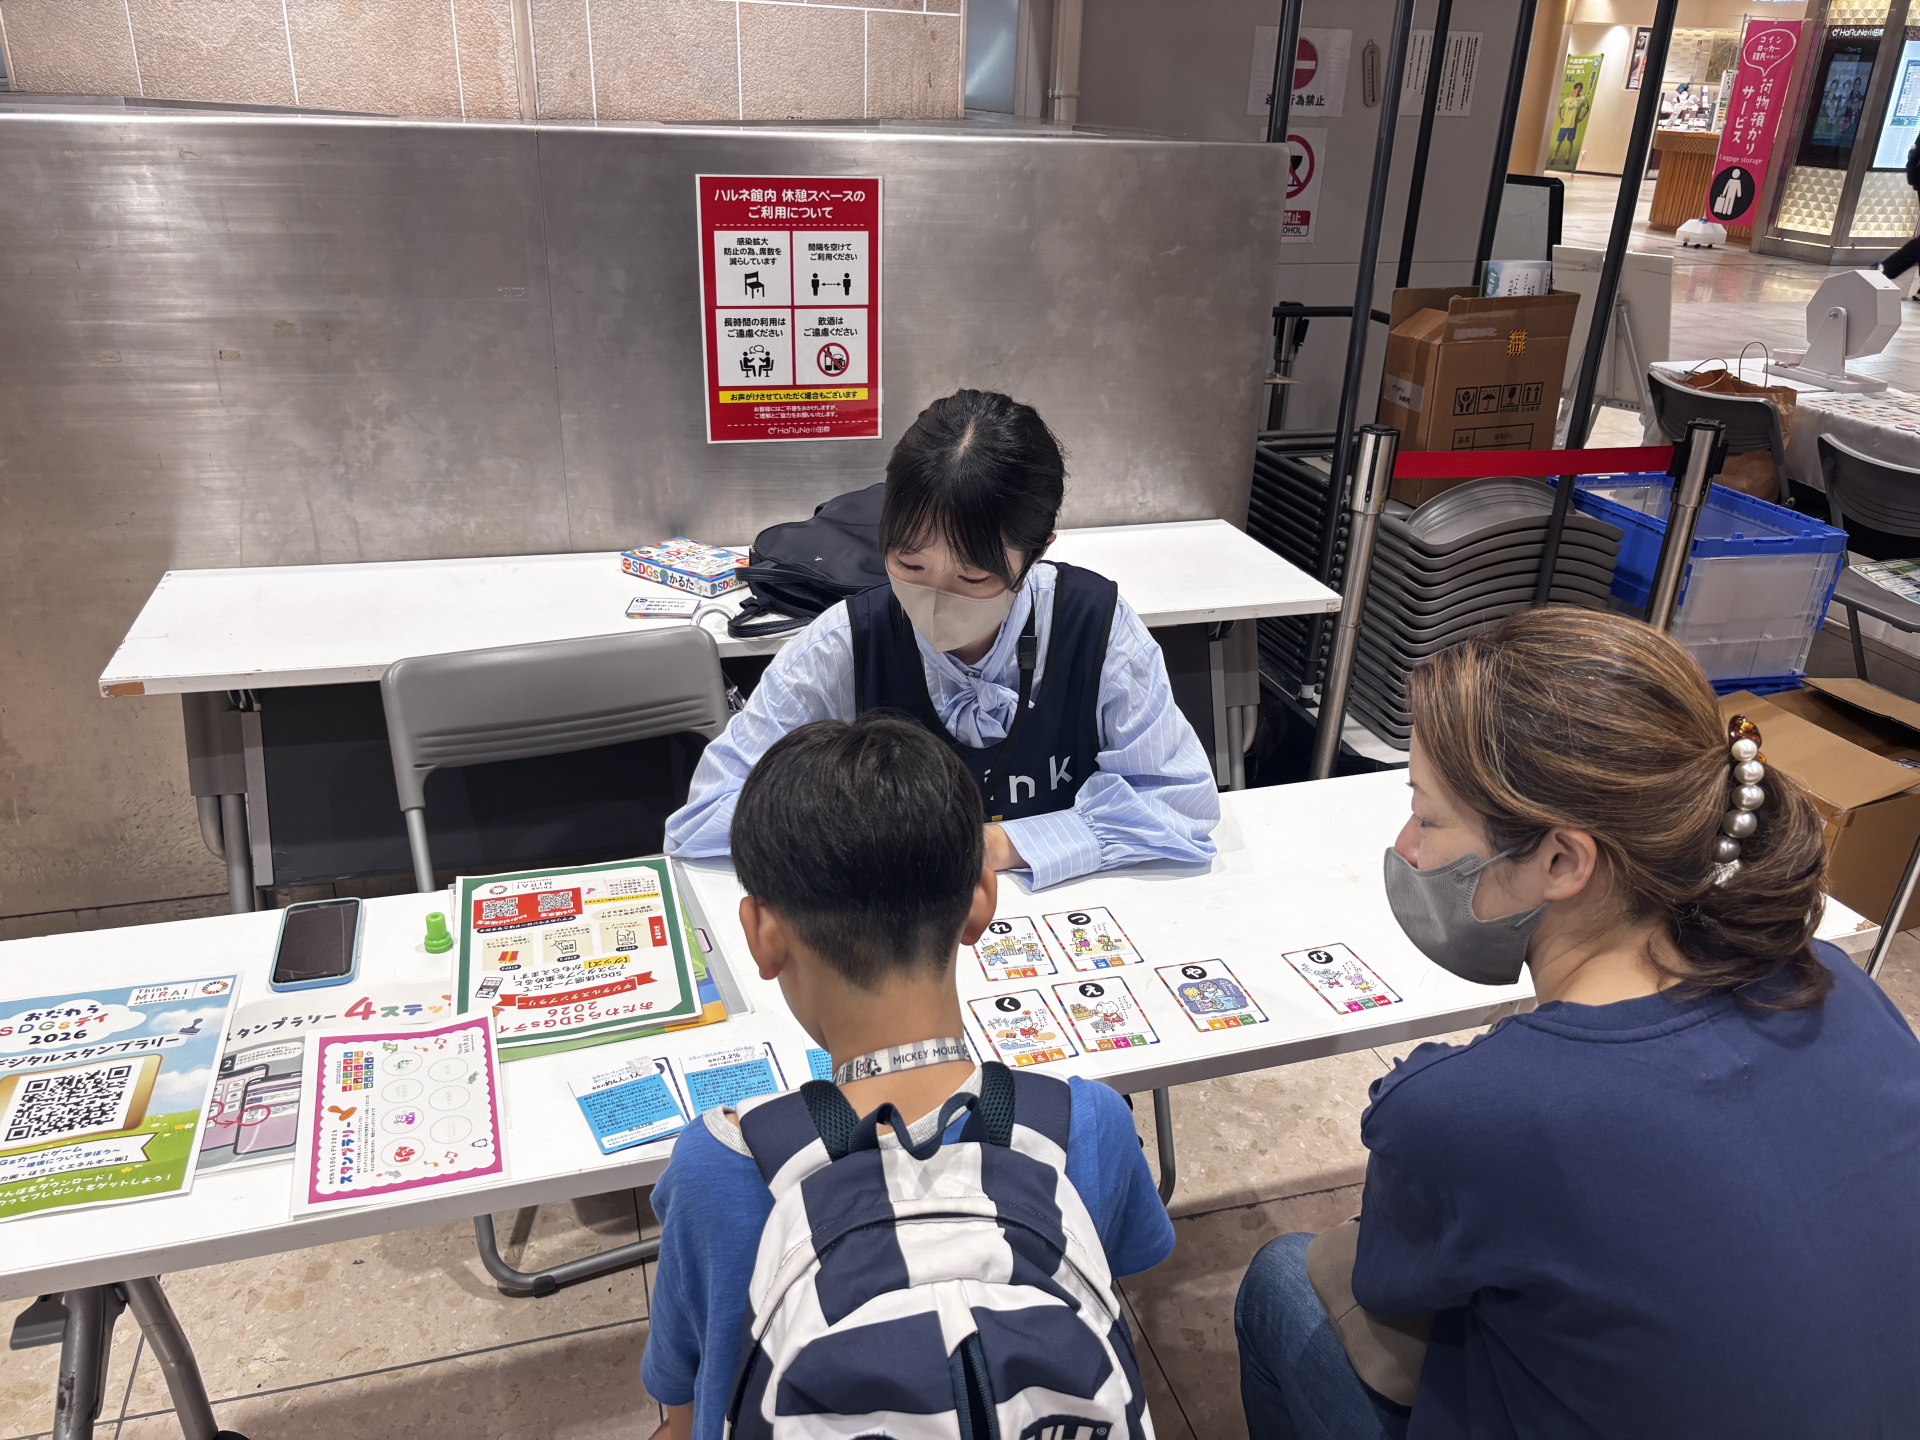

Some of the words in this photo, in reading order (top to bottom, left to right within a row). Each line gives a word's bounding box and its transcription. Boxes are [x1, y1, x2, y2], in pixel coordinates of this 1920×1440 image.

[1760, 36, 1783, 44] コイン
[1757, 45, 1780, 53] ロッカー
[1732, 86, 1755, 144] サービス
[1745, 78, 1774, 156] 荷物預かり
[1719, 153, 1739, 163] Luggage
[1741, 156, 1763, 165] storage
[714, 189, 777, 202] ハルネ館内
[781, 189, 866, 203] 休憩スペースの
[748, 206, 834, 219] ご利用について
[736, 237, 769, 246] 感染拡大
[808, 243, 852, 251] 間隔を空けて
[724, 247, 782, 256] 防止の為、席数を
[810, 253, 858, 261] ご利用ください
[729, 257, 777, 265] 減らしています
[724, 317, 786, 326] 長時間の利用は
[818, 316, 844, 326] 飲酒は
[727, 328, 784, 338] ご遠慮ください
[803, 327, 858, 337] ご遠慮ください
[730, 391, 858, 401] お声がけさせていただく場合もございます
[631, 560, 659, 580] SDGs
[669, 572, 695, 591] かるた
[717, 578, 739, 592] SDGs
[516, 880, 553, 890] MIRAI
[1071, 914, 1088, 924] つ
[991, 923, 1010, 934] れ
[1187, 967, 1203, 979] や
[524, 971, 622, 993] SDGs体感ブースにて
[134, 988, 189, 1002] MIRAI
[137, 986, 170, 995] Think
[517, 982, 633, 1008] デジタルスタンプラリー
[1085, 985, 1102, 997] え
[547, 1001, 598, 1018] 2026
[1004, 998, 1016, 1010] く
[25, 1005, 100, 1022] おだわら
[498, 1001, 654, 1034] おだわらSDGsデイ
[0, 1013, 109, 1037] SDGsデイ
[29, 1030, 88, 1046] 2026
[893, 1050, 929, 1065] MICKEY
[932, 1045, 960, 1058] MOUSE
[223, 1060, 232, 1069] 2
[340, 1121, 355, 1185] スタンプラリー
